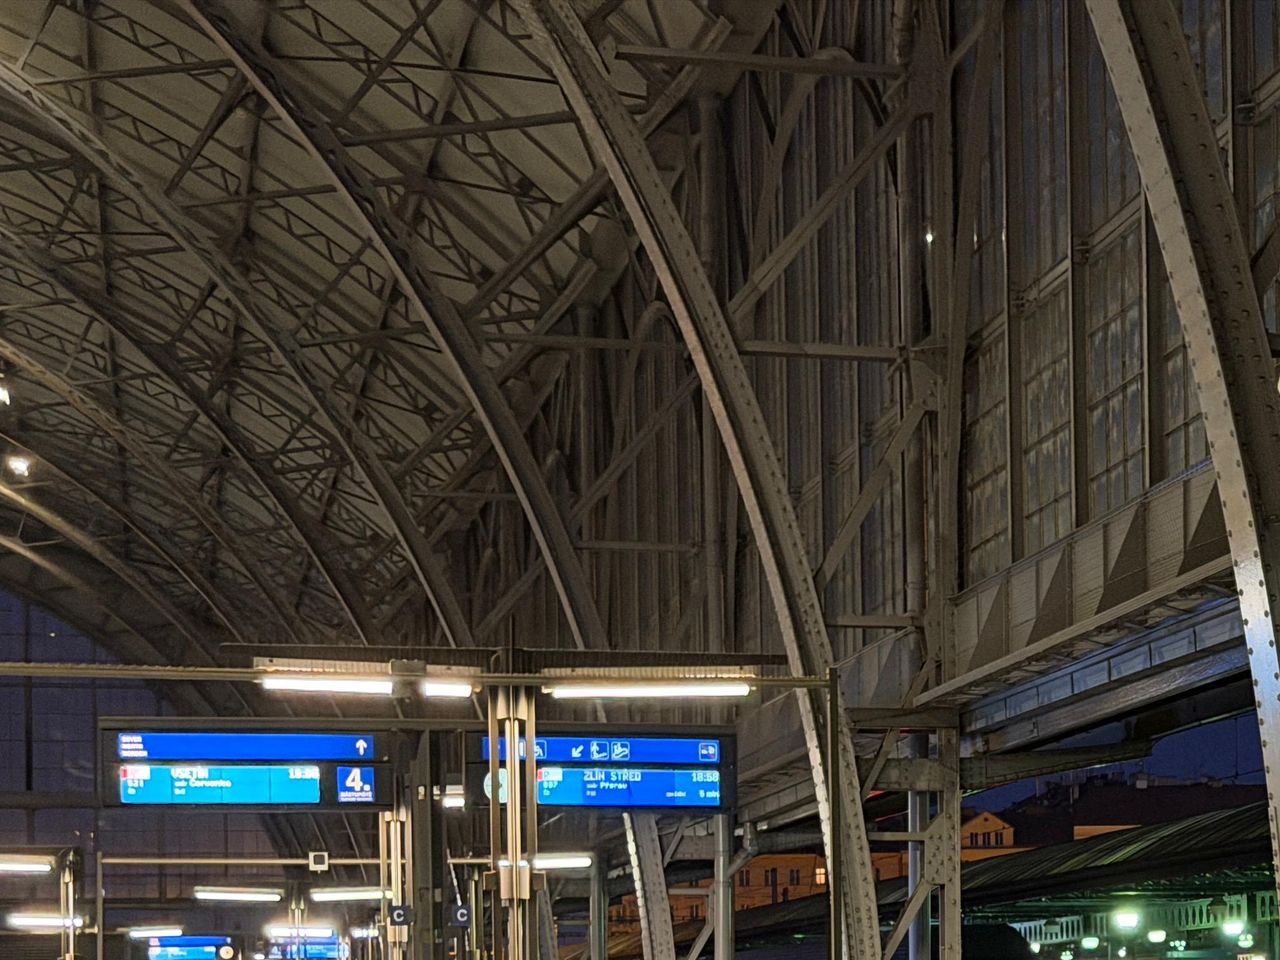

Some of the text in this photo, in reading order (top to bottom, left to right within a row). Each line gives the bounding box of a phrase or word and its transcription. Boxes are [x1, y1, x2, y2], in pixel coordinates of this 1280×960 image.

[345, 767, 371, 791] 4.
[393, 909, 405, 922] C
[457, 908, 468, 921] C
